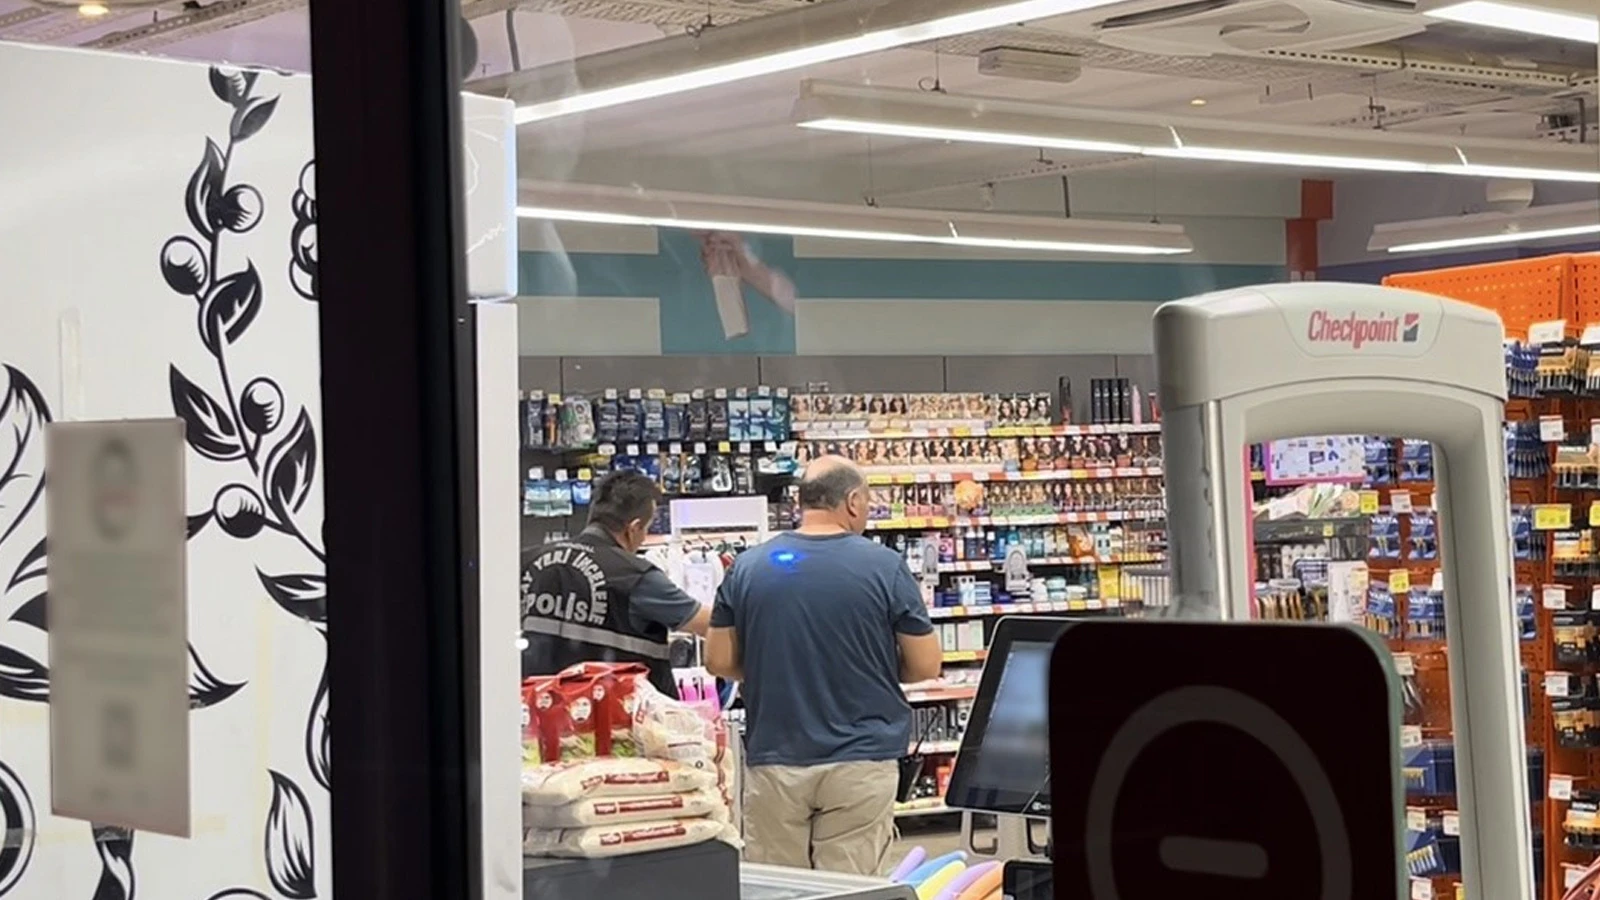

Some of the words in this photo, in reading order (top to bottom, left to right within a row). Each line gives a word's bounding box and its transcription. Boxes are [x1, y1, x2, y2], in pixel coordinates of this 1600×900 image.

[1308, 310, 1399, 349] Checkpoint
[525, 592, 589, 621] POLİS
[572, 551, 608, 625] İNCELEME
